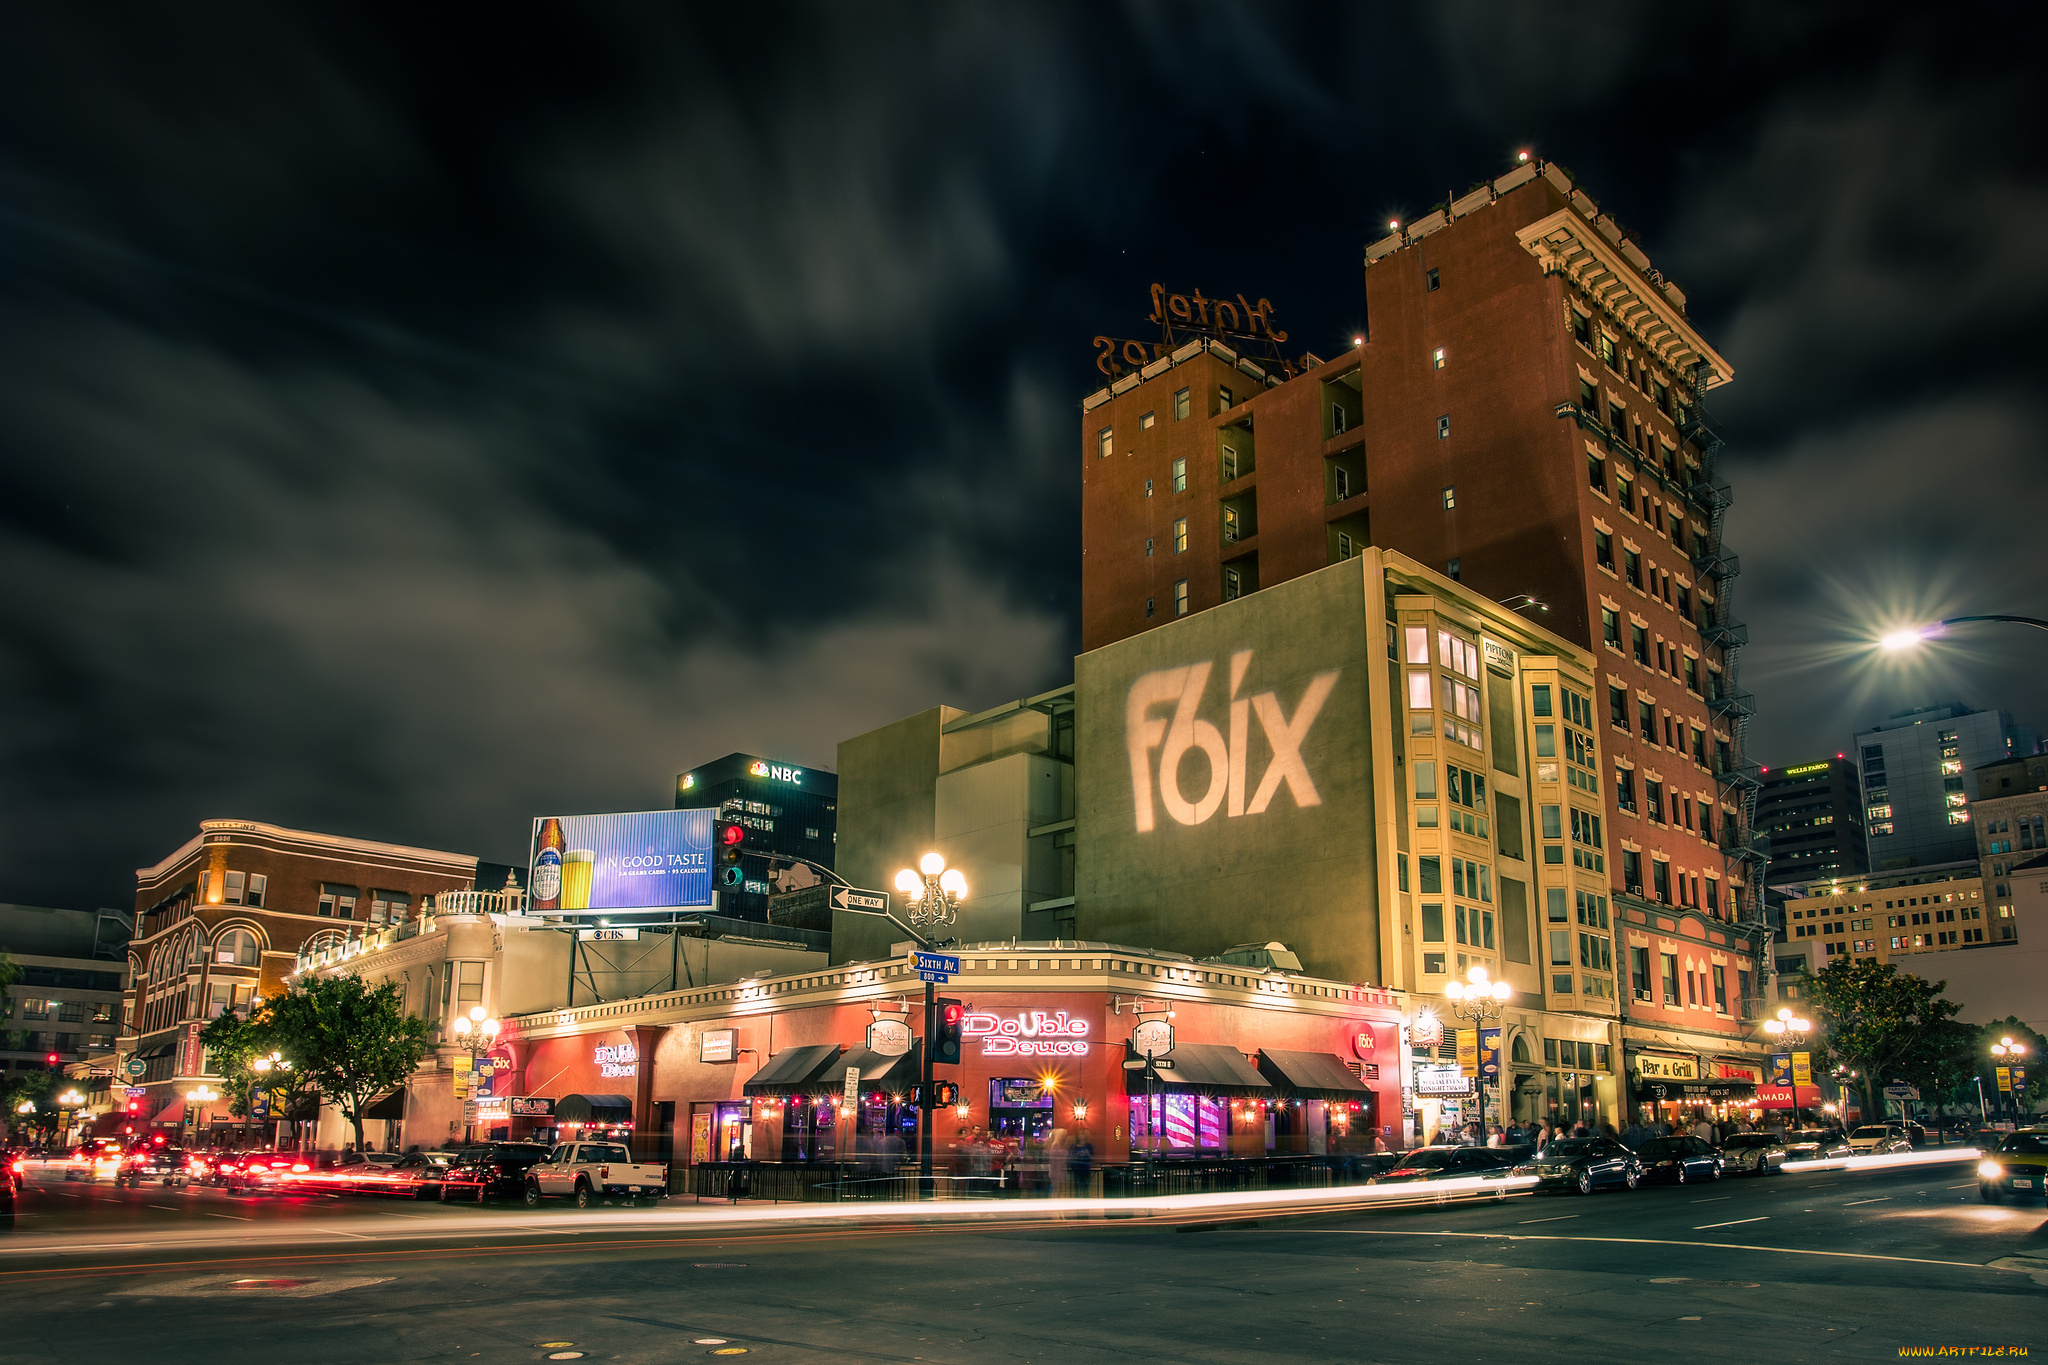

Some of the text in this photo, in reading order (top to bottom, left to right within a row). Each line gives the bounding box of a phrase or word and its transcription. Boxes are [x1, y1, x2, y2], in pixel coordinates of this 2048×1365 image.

[771, 765, 802, 785] NBC
[1786, 763, 1829, 775] WELLS FARGO
[604, 853, 708, 869] IN GOOD TASTE.
[847, 896, 879, 907] ONE WAY
[604, 930, 624, 940] CBS
[923, 972, 935, 981] 800
[982, 1036, 1089, 1056] Deuce
[186, 1039, 196, 1075] KEATING
[1642, 1059, 1692, 1077] Bar & Grill
[1757, 1093, 1791, 1101] AMADA
